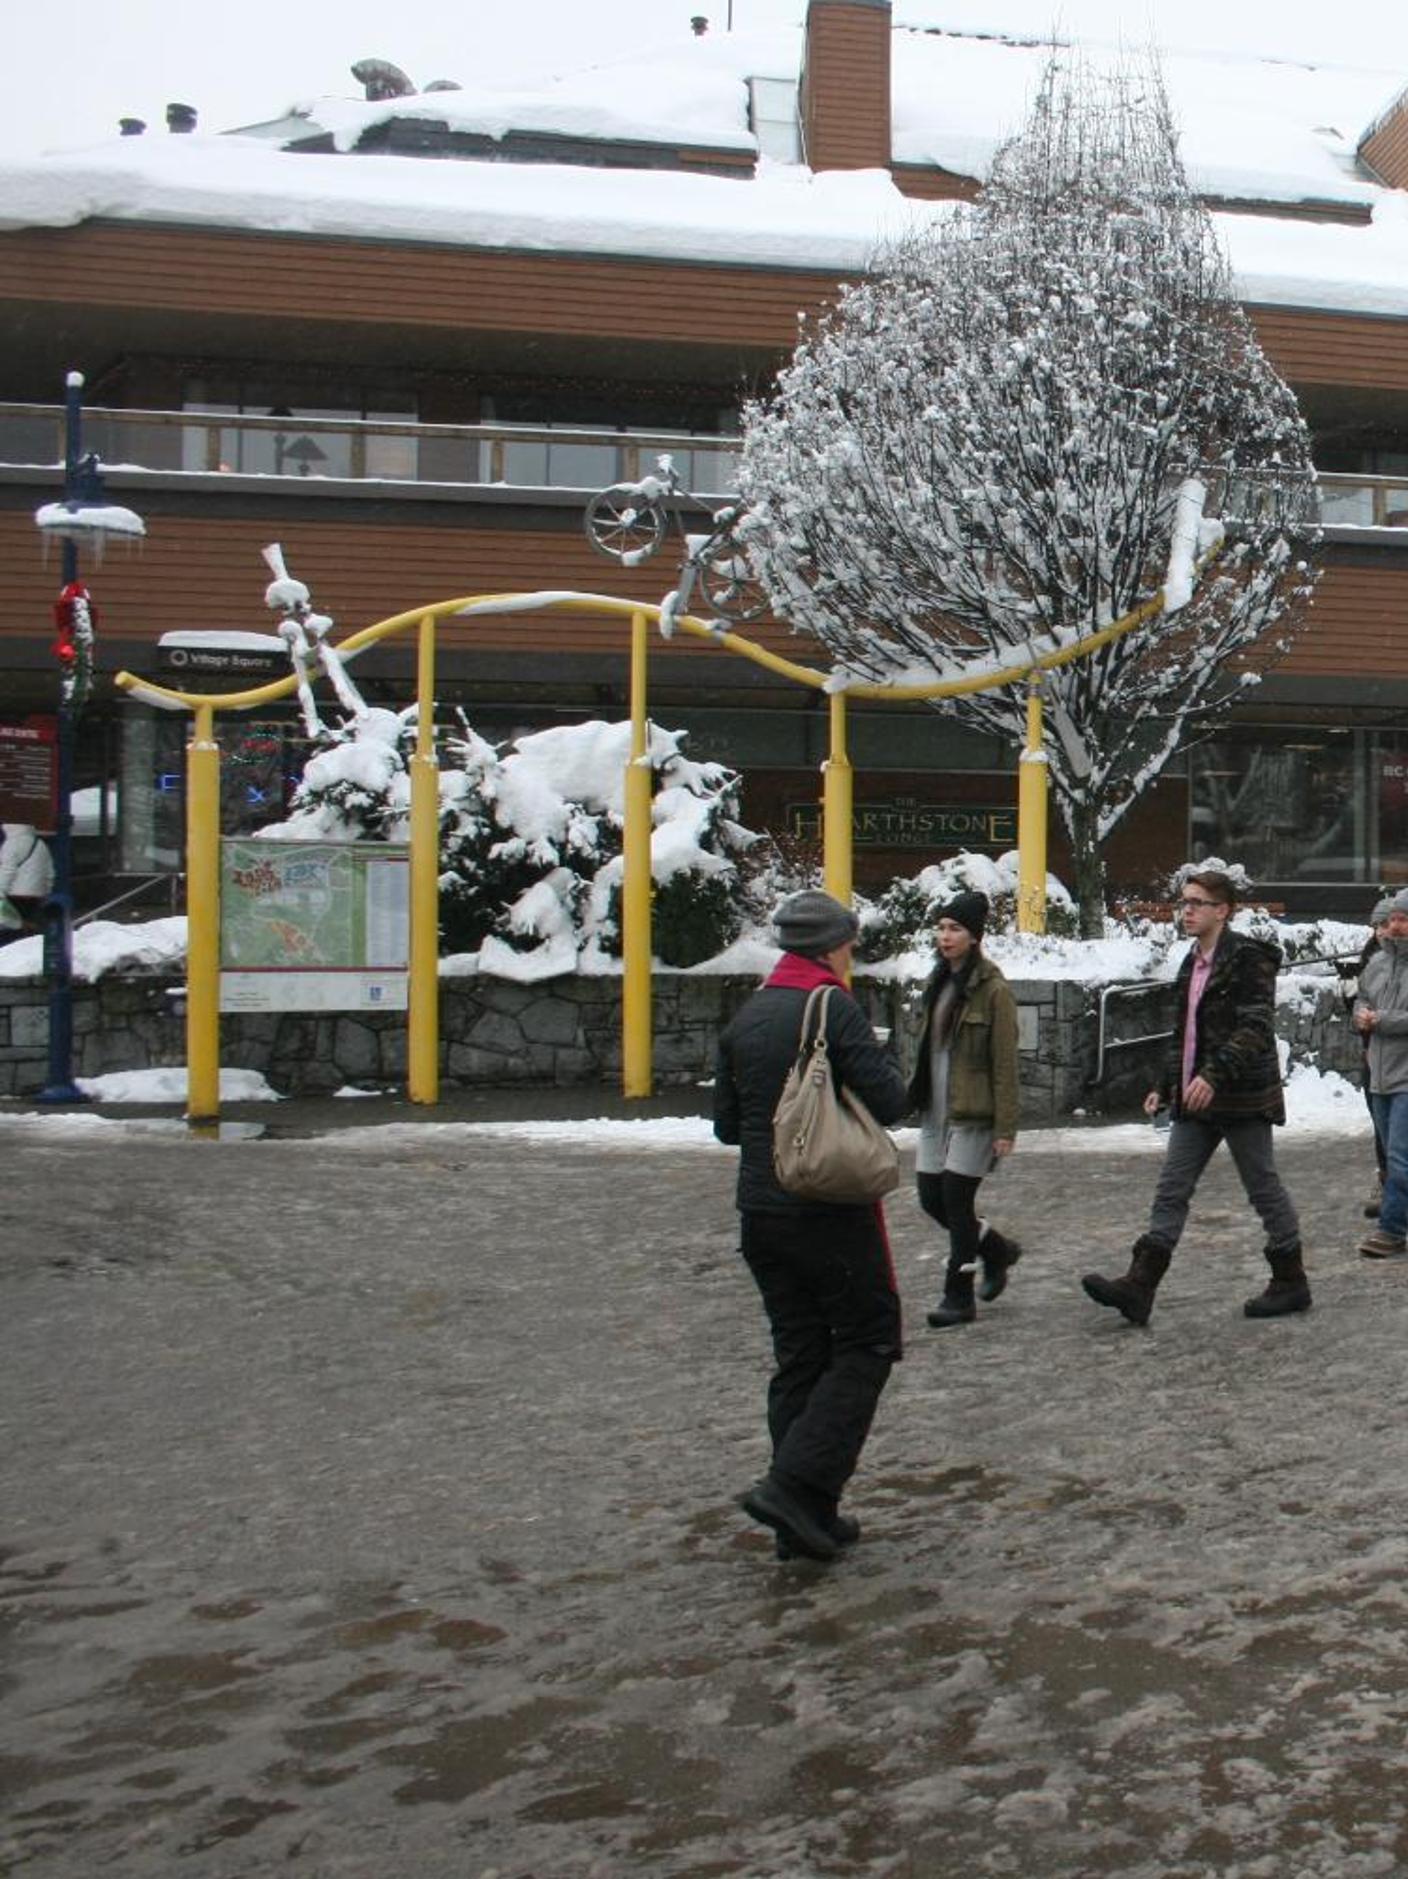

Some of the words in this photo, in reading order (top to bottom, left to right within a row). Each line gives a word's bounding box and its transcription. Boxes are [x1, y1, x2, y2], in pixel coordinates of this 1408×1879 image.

[191, 653, 229, 667] Village
[232, 655, 272, 669] Square
[1383, 765, 1403, 776] BC
